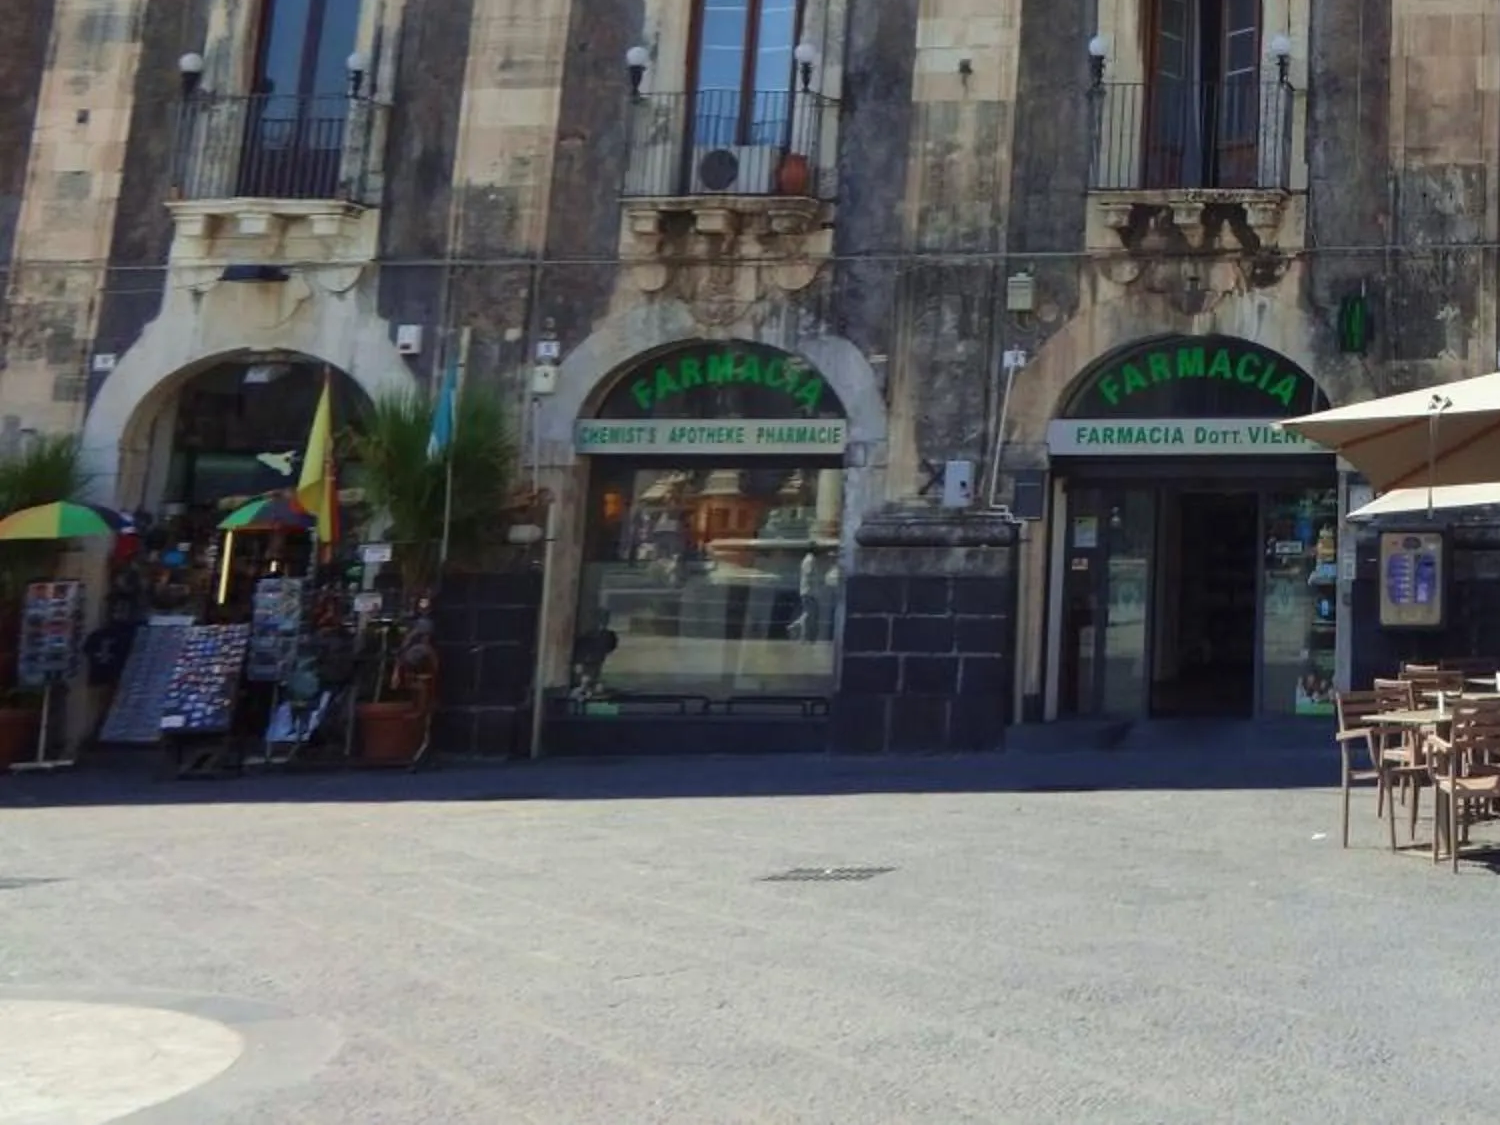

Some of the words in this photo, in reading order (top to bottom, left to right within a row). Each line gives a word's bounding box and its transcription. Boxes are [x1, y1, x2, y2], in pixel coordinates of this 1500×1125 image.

[630, 350, 823, 411] FARMACIA
[1098, 347, 1298, 407] FARMACIA
[581, 426, 658, 444] CHEMIST'S
[668, 426, 745, 444] APOTHEKE
[756, 426, 842, 444] PHARMACIE
[1075, 426, 1185, 444] FARMACIA
